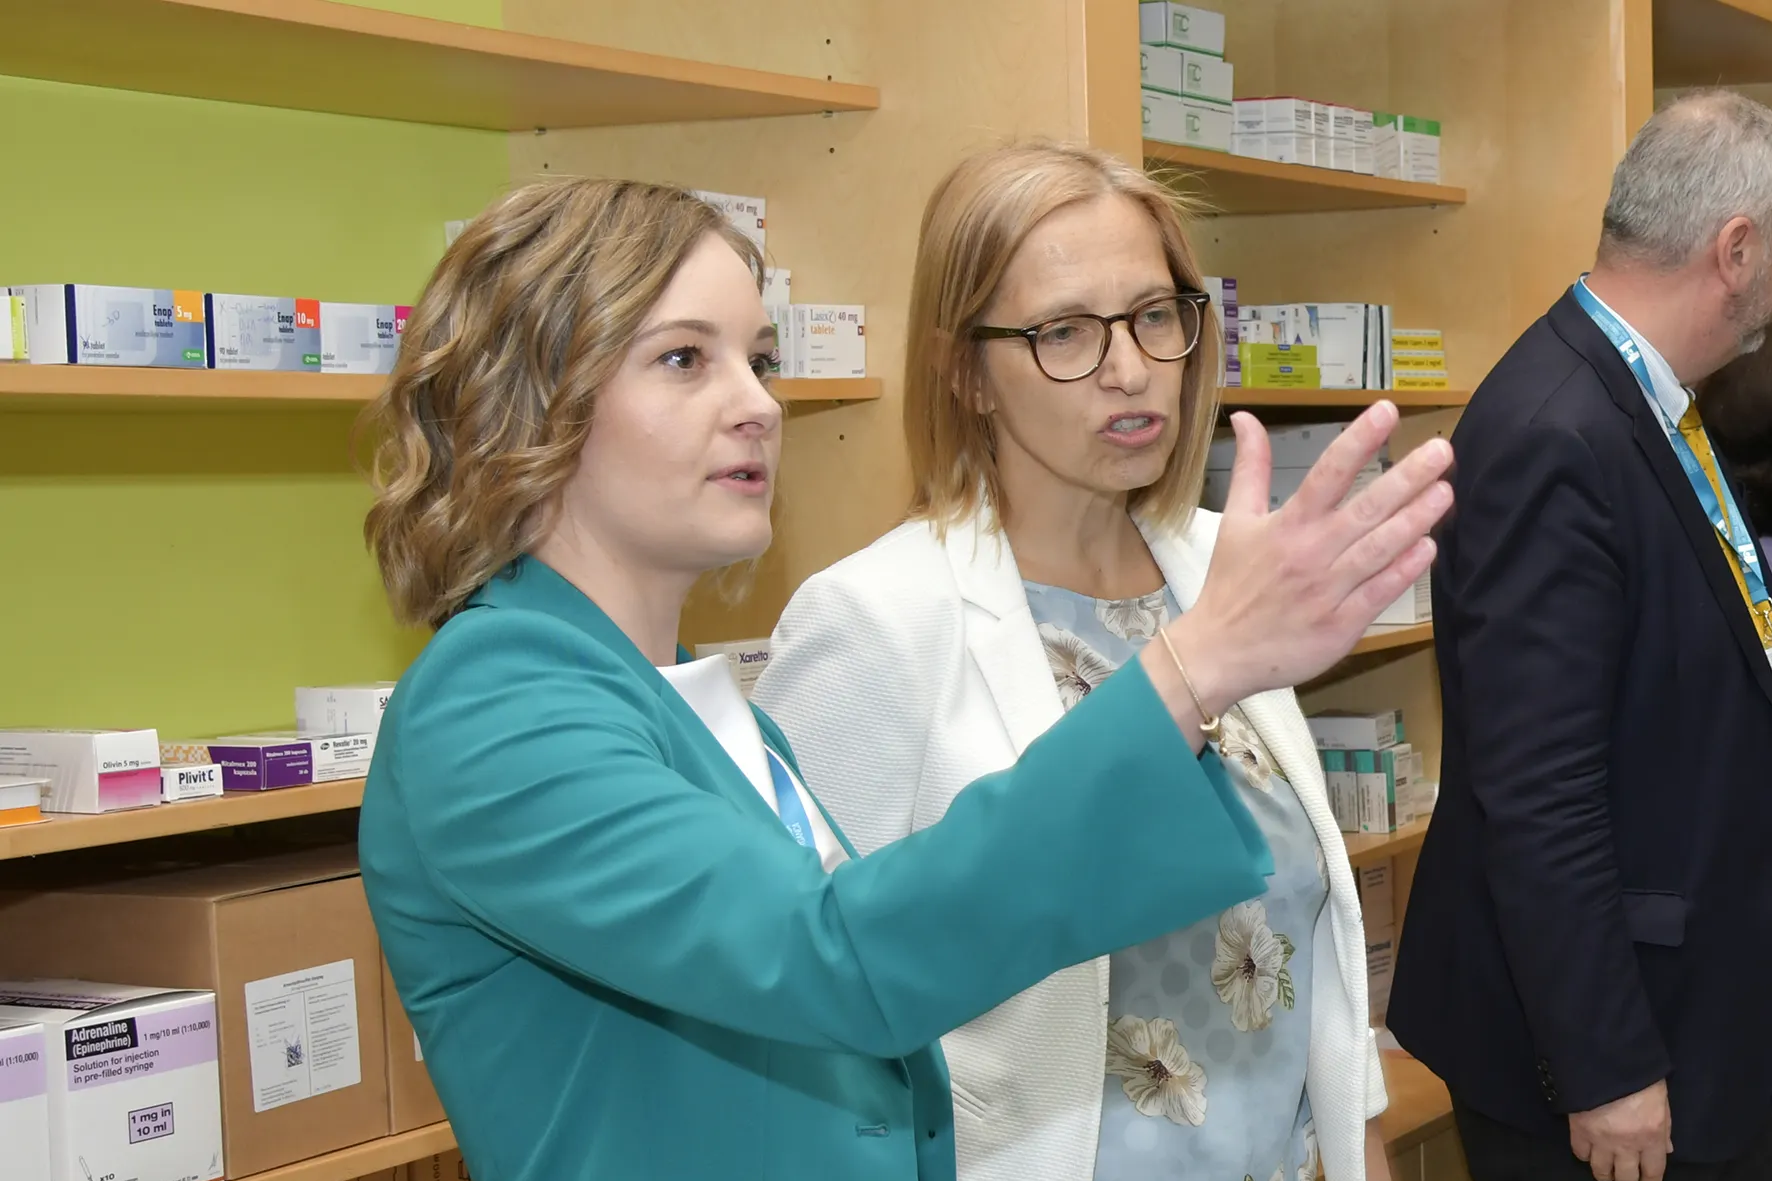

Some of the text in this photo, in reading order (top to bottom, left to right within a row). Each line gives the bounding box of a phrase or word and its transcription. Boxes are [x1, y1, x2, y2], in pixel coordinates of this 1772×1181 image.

[176, 306, 182, 318] 5
[183, 311, 192, 320] mg
[296, 312, 306, 324] 10
[838, 312, 846, 321] 40
[848, 313, 858, 324] mg
[739, 650, 768, 664] Xarelto
[102, 760, 122, 769] Olivin
[129, 760, 140, 768] mg
[178, 770, 214, 785] Plivit C
[72, 1020, 128, 1043] Adrenaline
[144, 1020, 211, 1041] 1 mg/10 ml (1:10,000)
[72, 1035, 132, 1059] (Epinephrine)
[6, 1052, 39, 1067] (1:10,000)
[74, 1048, 160, 1074] Solution for injection
[74, 1060, 154, 1084] in pre-filled syringe
[131, 1108, 171, 1124] 1 mg in
[136, 1122, 167, 1136] 10 ml
[100, 1172, 115, 1181] x10
